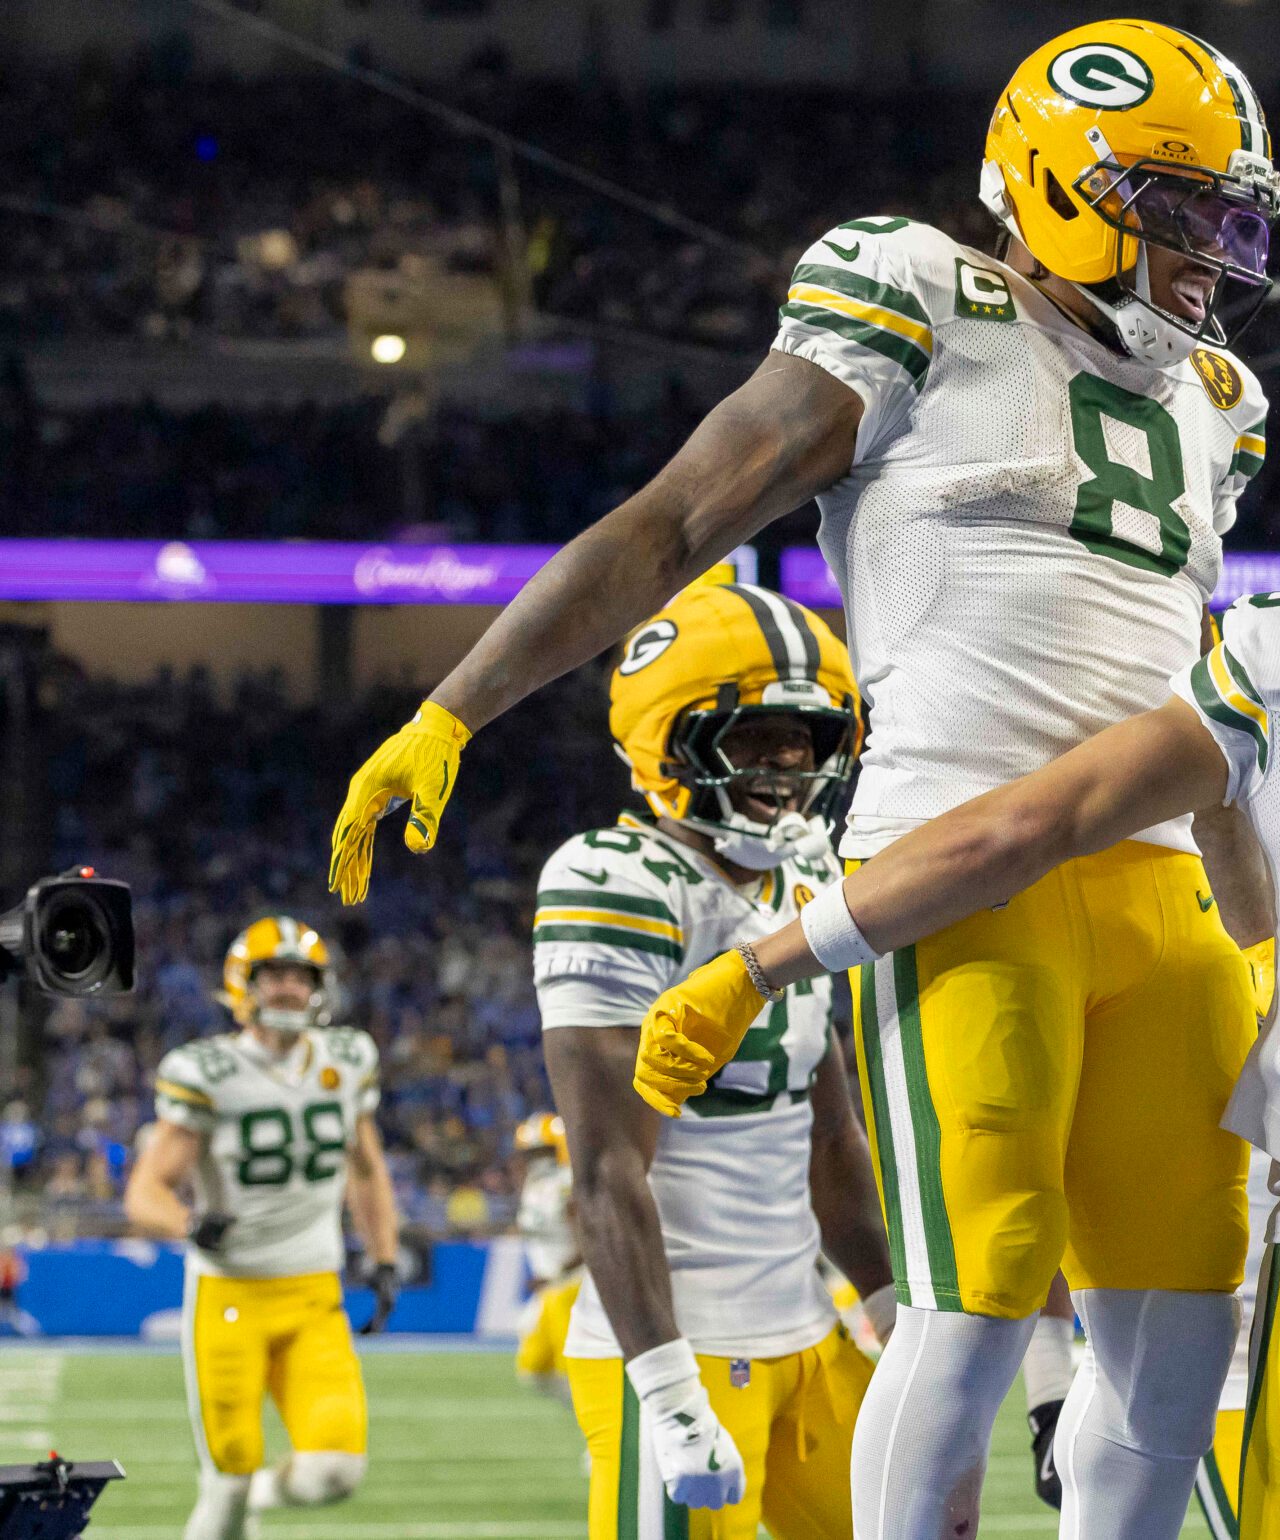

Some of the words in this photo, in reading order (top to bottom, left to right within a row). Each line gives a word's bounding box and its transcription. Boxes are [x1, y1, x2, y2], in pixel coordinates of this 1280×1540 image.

[1153, 149, 1195, 162] OAKLEY
[960, 264, 1009, 306] C
[1068, 370, 1192, 578] 8
[239, 1102, 346, 1187] 88
